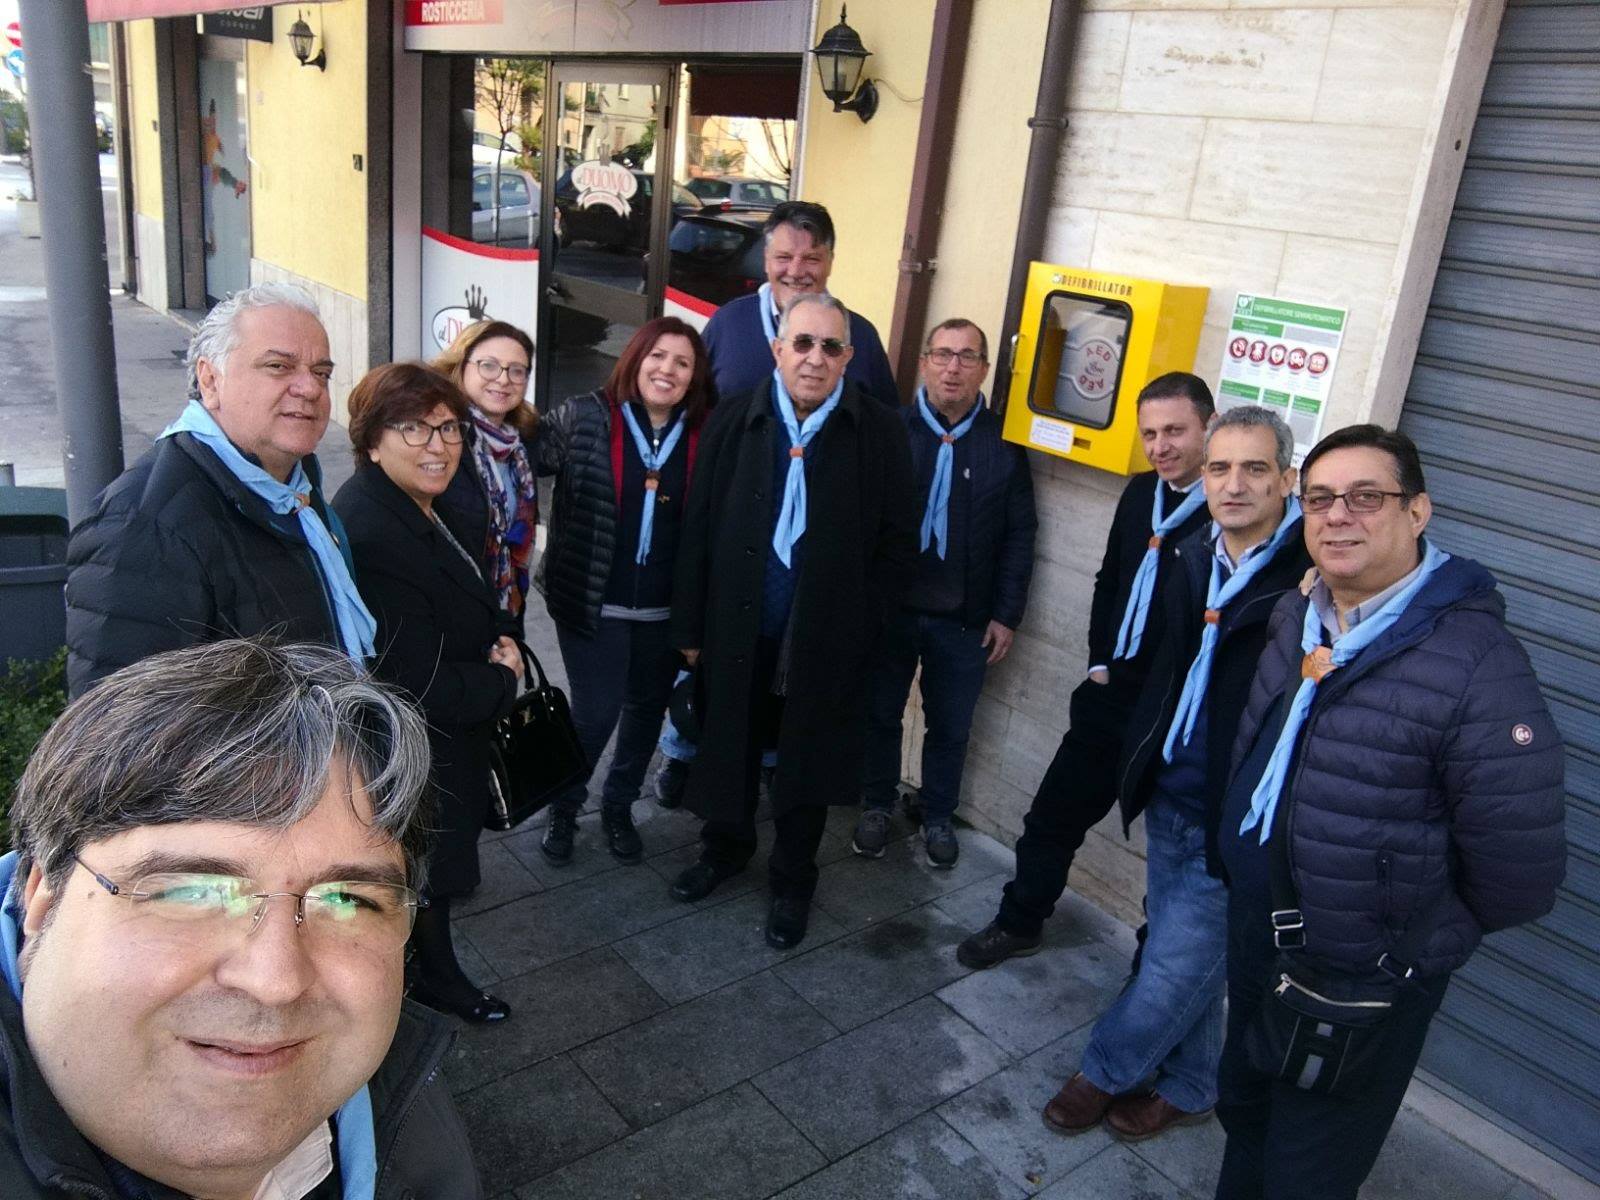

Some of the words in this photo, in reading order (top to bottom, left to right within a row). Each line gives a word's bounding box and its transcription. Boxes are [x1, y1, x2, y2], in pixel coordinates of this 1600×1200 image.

[421, 0, 485, 22] ROSTICCERIA
[1061, 274, 1133, 297] DEFIBRILLATOR
[1087, 344, 1111, 362] AED
